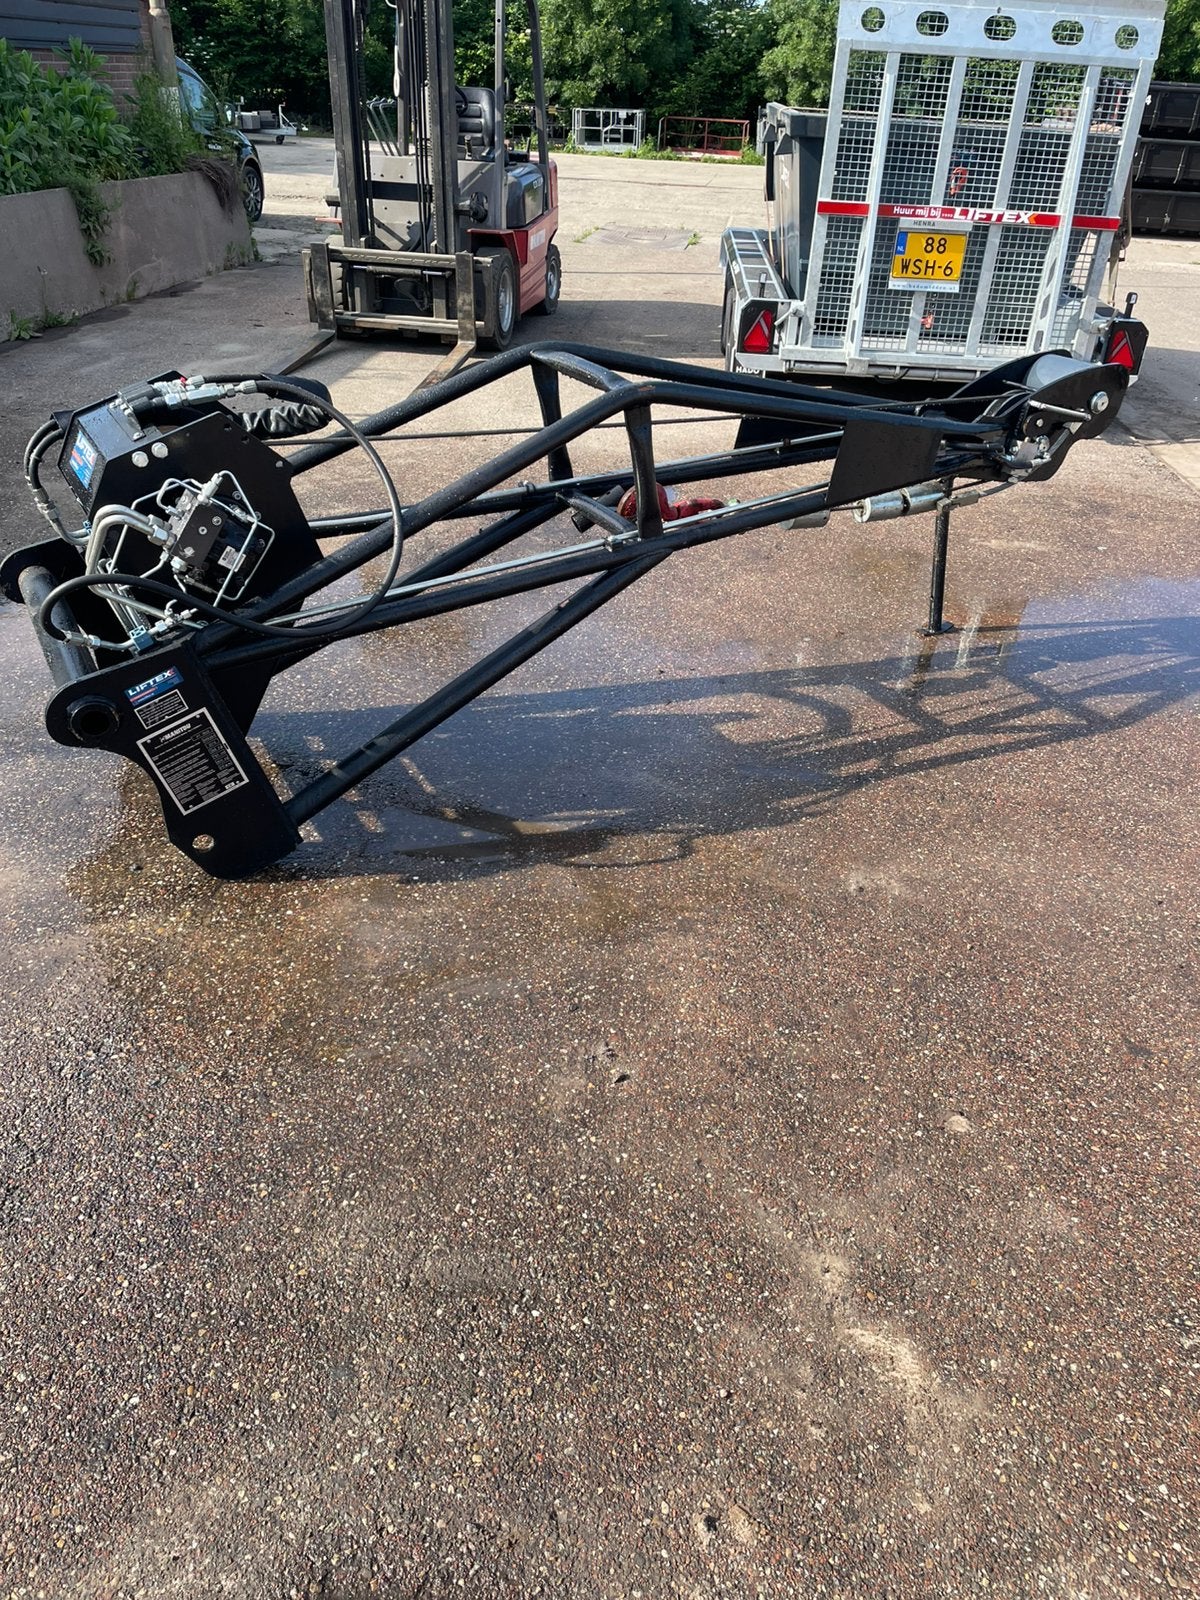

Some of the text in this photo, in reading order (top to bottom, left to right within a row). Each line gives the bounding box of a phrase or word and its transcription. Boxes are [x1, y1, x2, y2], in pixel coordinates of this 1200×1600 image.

[893, 206, 915, 215] Huur
[915, 207, 929, 218] mij
[953, 208, 1033, 224] LIFTEX
[924, 237, 947, 254] 88
[901, 258, 953, 277] WSH-6
[128, 669, 172, 696] LIFTEX
